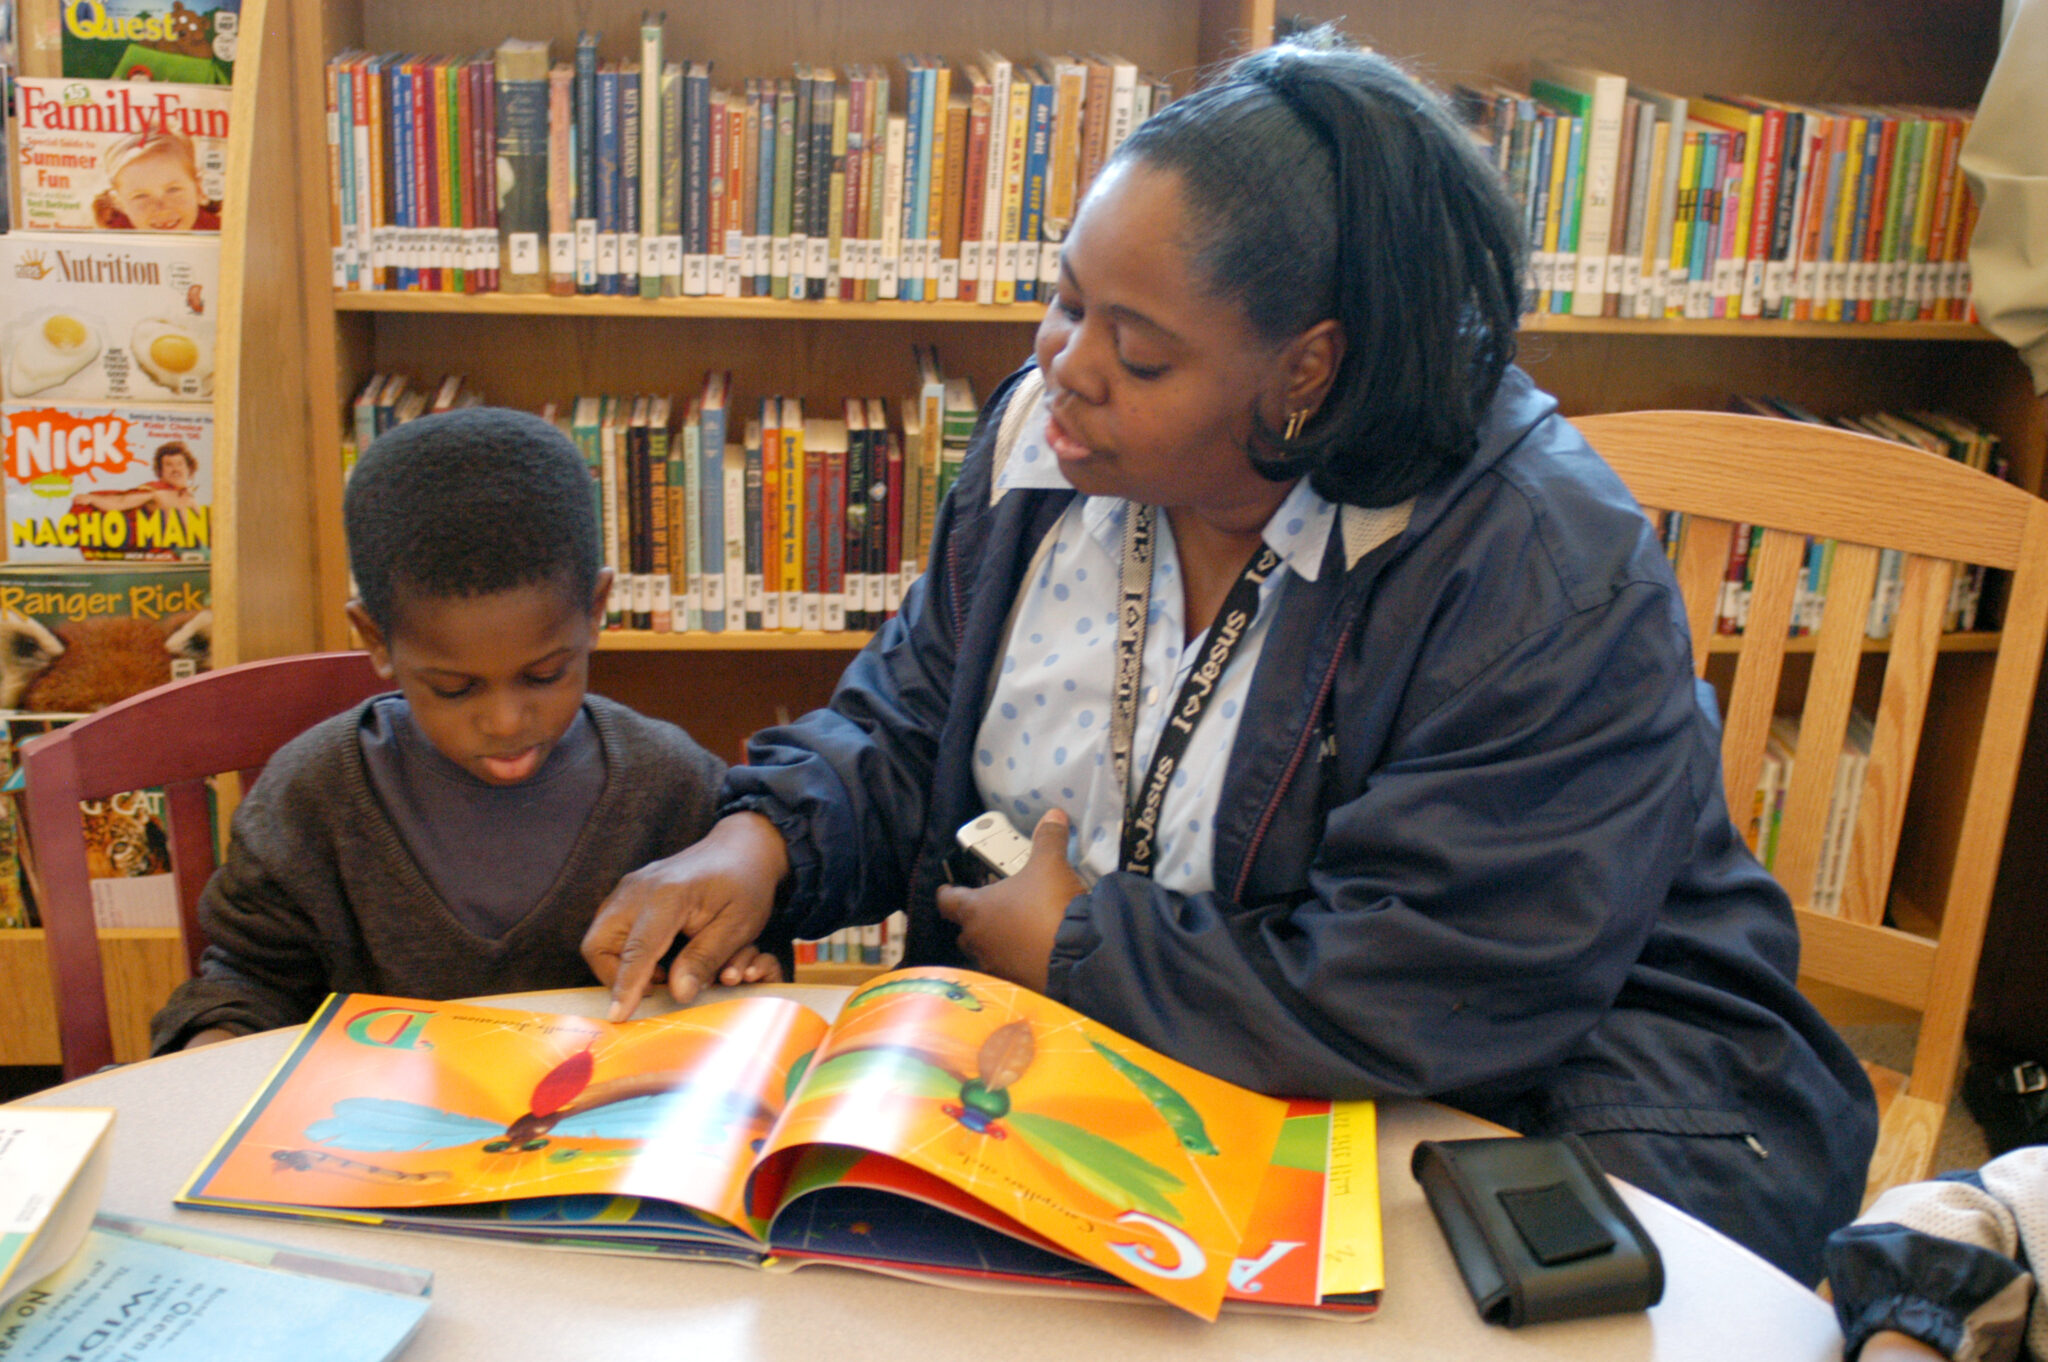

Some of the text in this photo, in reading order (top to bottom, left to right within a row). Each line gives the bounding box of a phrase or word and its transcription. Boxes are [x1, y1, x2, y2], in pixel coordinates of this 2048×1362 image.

[64, 0, 178, 40] Quest
[21, 86, 229, 148] FamilyFun
[20, 147, 97, 169] Summer
[624, 117, 638, 179] WILDERNESS
[37, 169, 70, 189] Fun
[57, 250, 160, 285] Nutrition
[16, 421, 124, 478] NICK
[12, 504, 211, 549] NACHO MAN
[0, 582, 204, 622] Ranger Rick
[1171, 609, 1248, 736] I Jesus
[1134, 755, 1175, 842] Jesus
[344, 1006, 440, 1051] D
[1106, 1210, 1207, 1280] C
[1227, 1241, 1308, 1293] A
[0, 1289, 53, 1360] No wa
[132, 1301, 193, 1352] Queen
